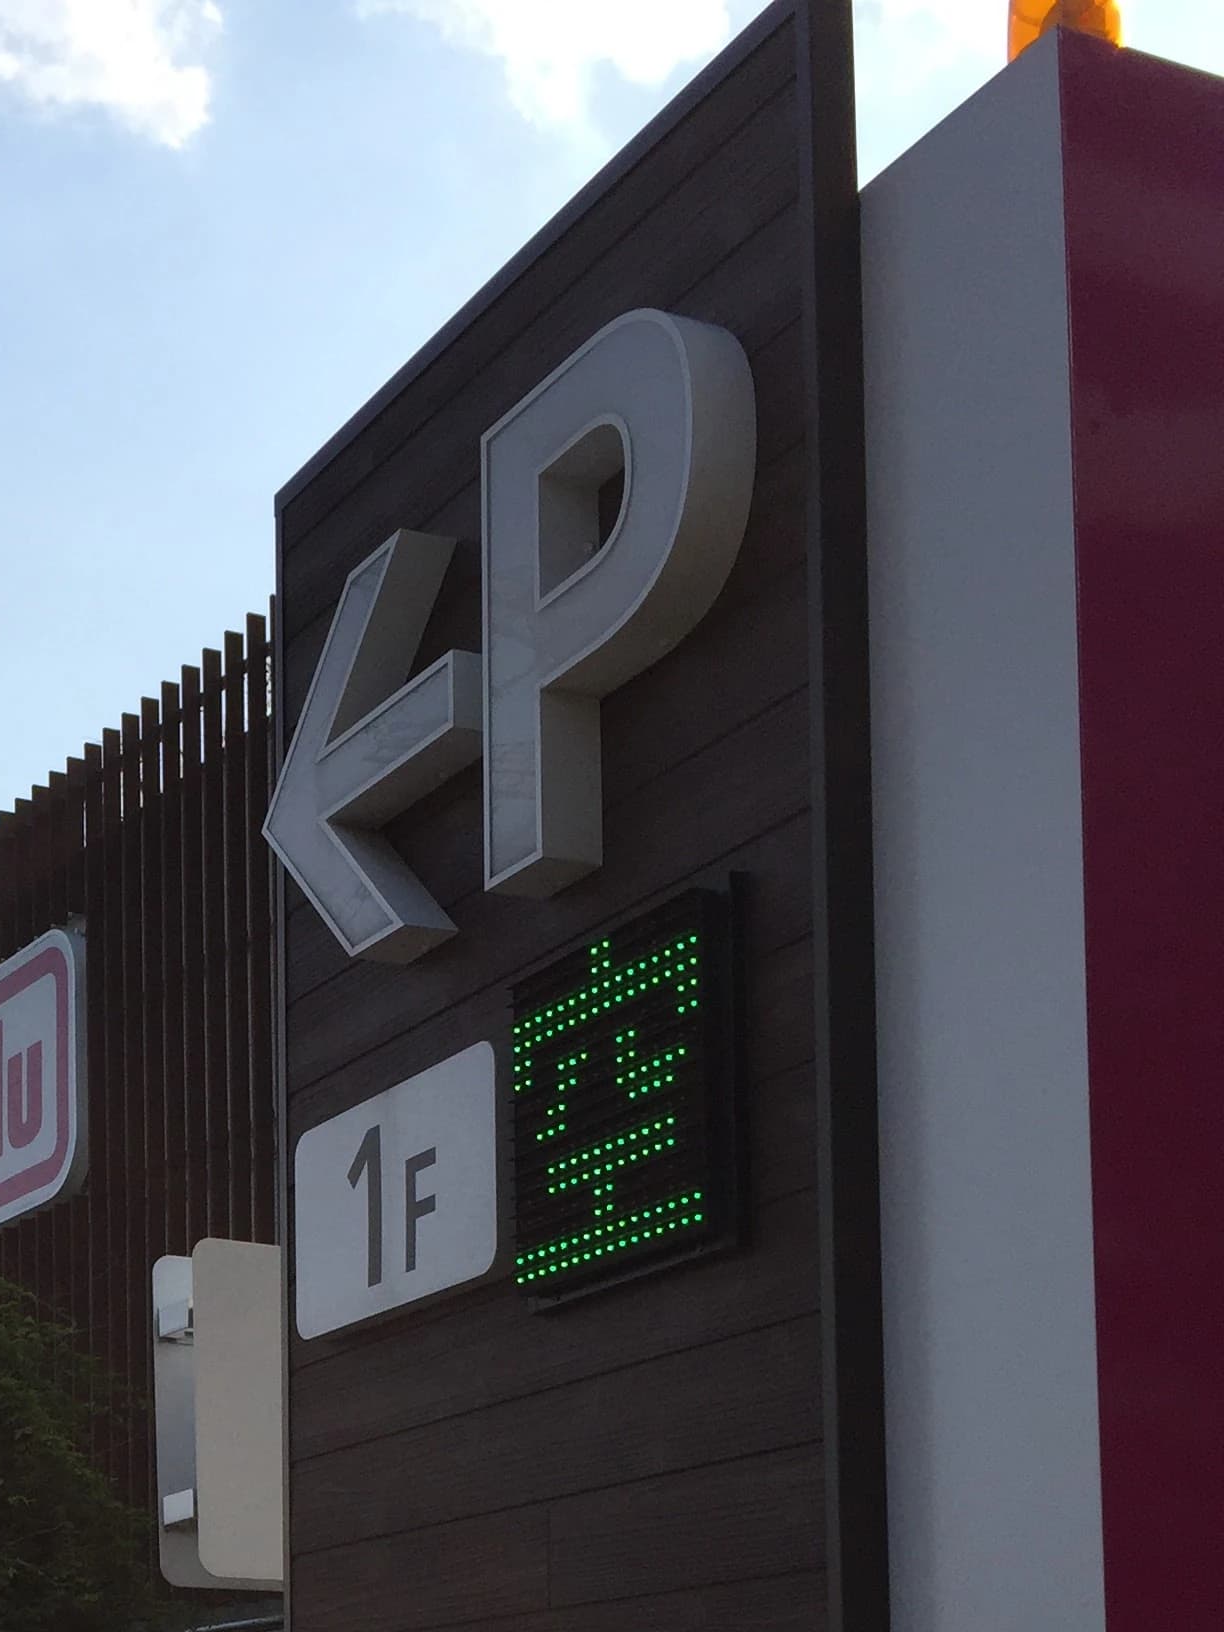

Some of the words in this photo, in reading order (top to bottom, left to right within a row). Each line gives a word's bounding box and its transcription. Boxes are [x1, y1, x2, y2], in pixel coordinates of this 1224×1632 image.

[481, 307, 757, 899] P
[346, 1125, 437, 1288] 1F
[513, 938, 704, 1285] 空
